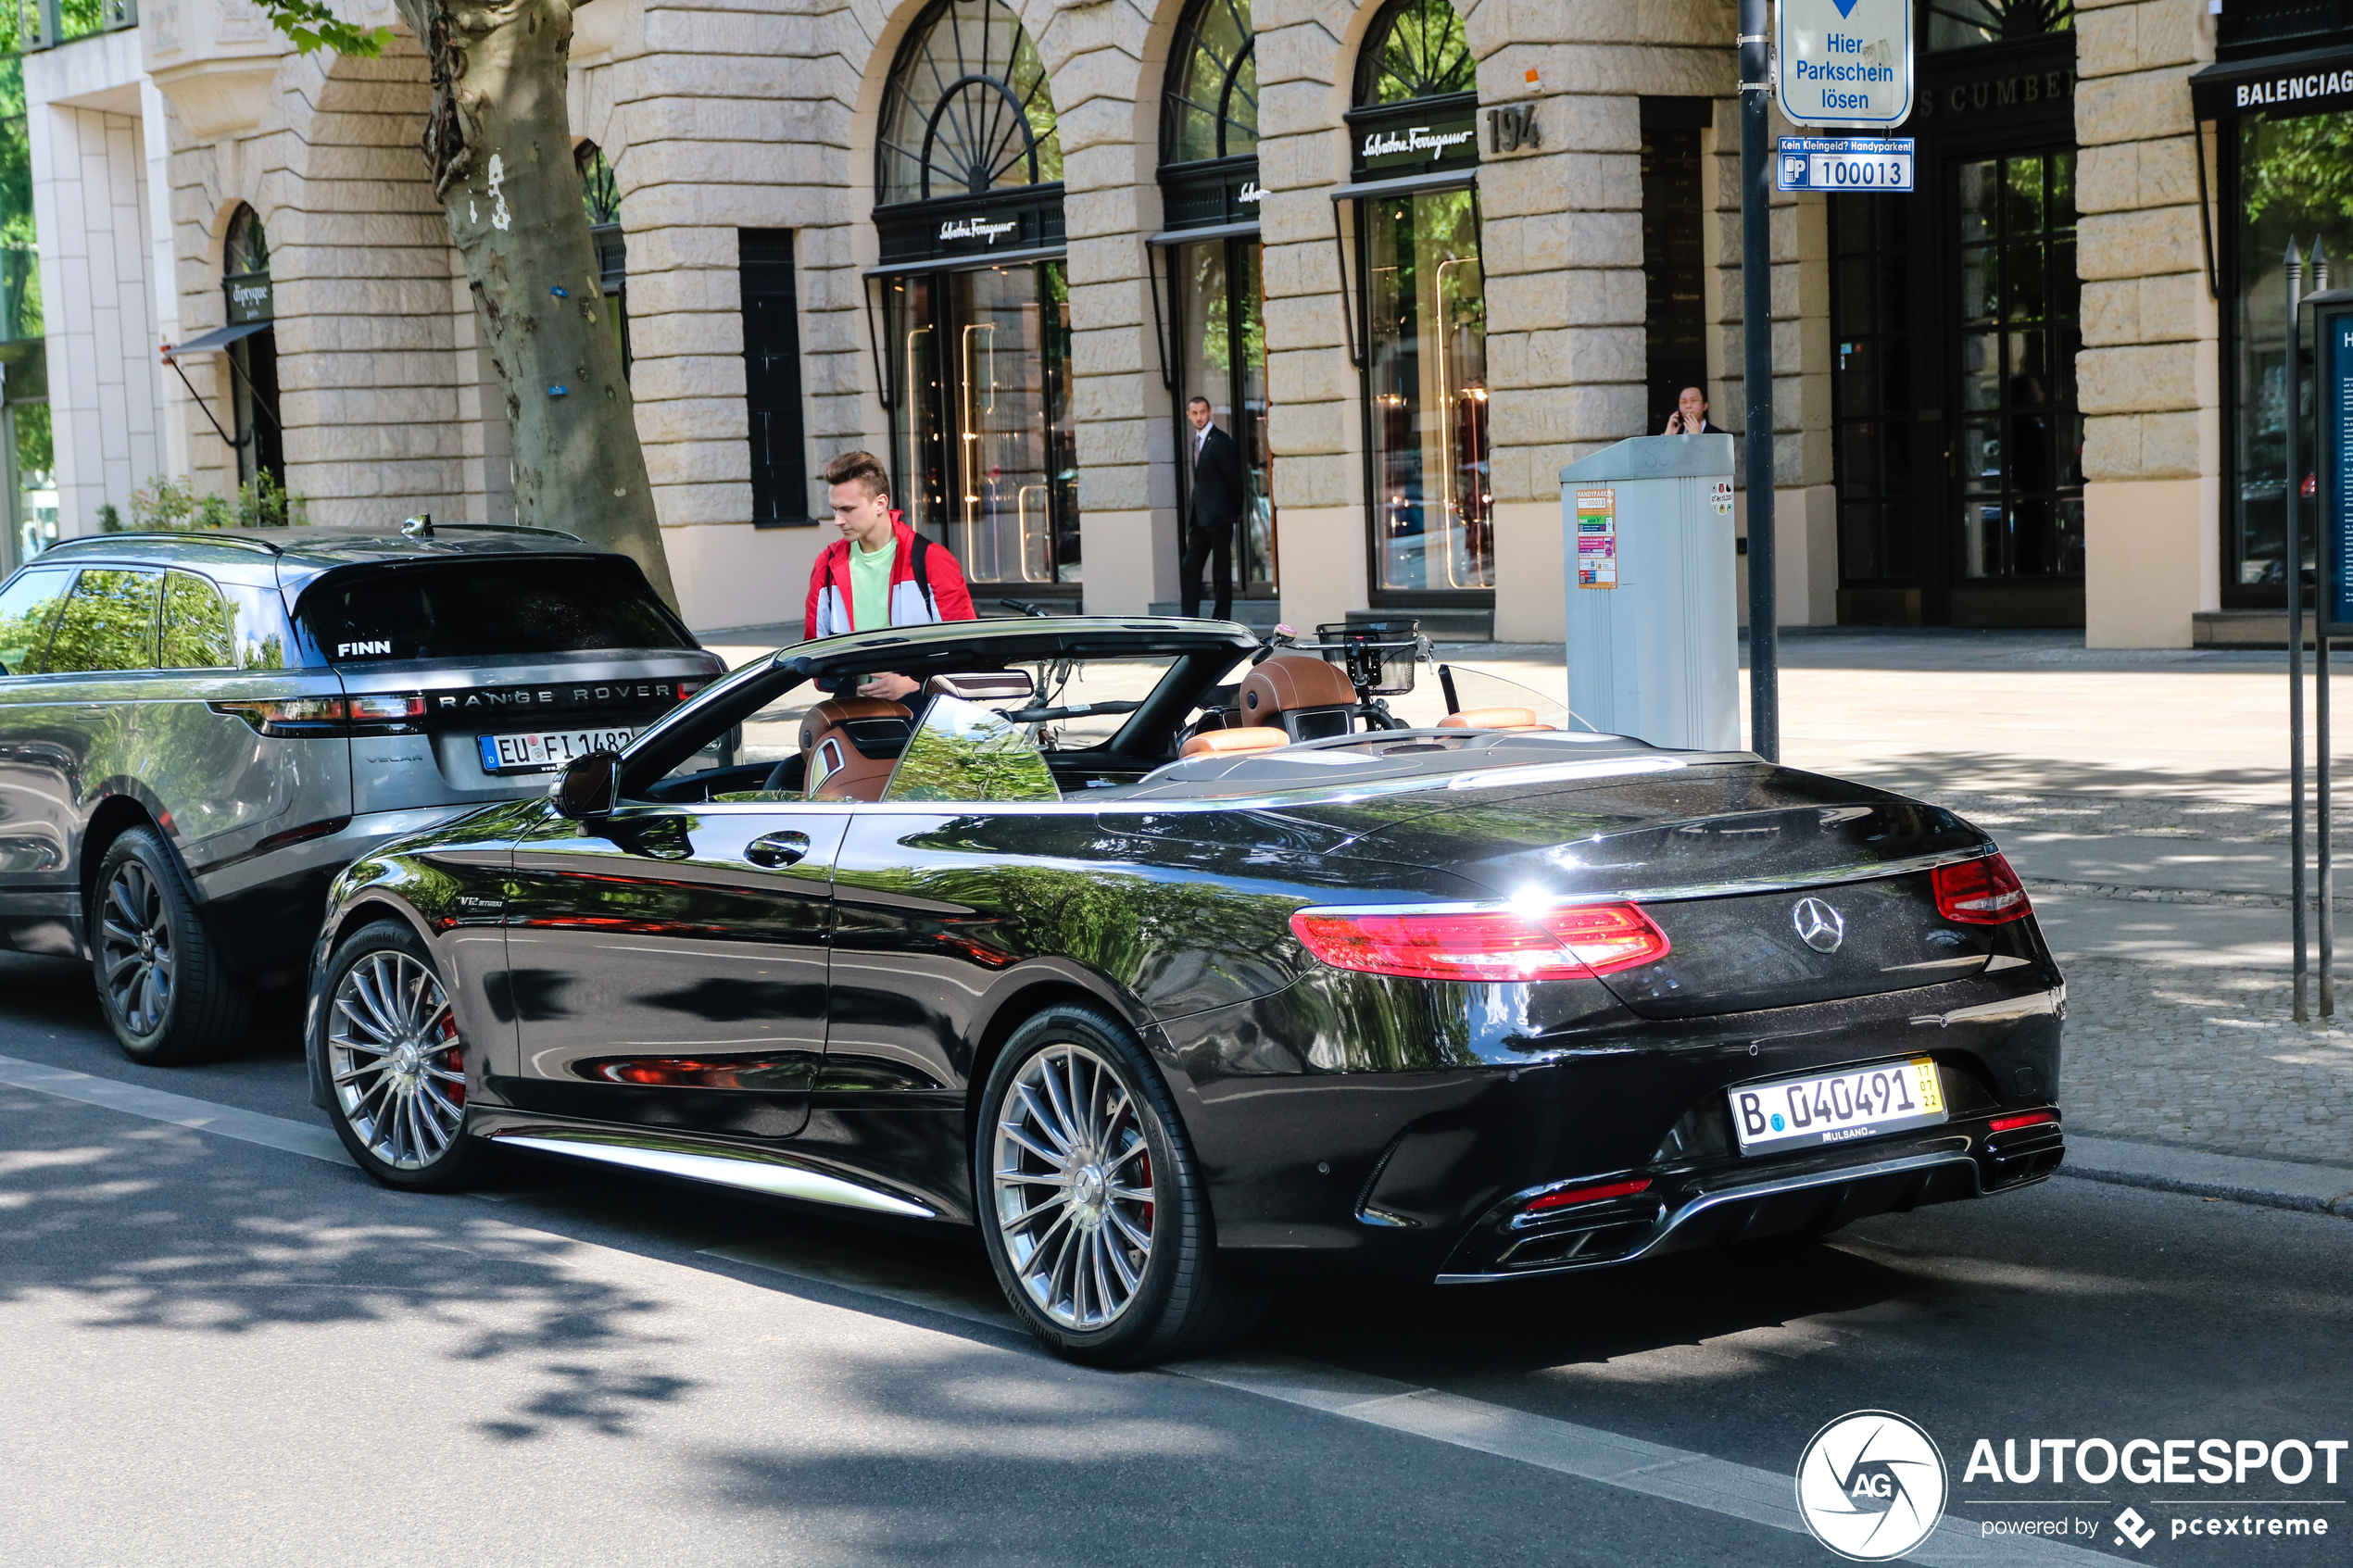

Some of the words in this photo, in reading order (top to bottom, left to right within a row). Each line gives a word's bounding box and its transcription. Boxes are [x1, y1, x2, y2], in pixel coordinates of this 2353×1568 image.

[1827, 33, 1863, 53] Hier
[1797, 60, 1893, 82] Parkschein
[1822, 89, 1869, 108] lösen
[2236, 69, 2353, 107] BALENCIAG
[1487, 105, 1539, 154] 194
[1362, 132, 1409, 157] Salvatore
[1409, 127, 1473, 160] Ferragamo
[1781, 141, 1800, 150] Kein
[1803, 141, 1848, 152] Kleingeld?
[1851, 142, 1911, 153] Handyparken!
[1823, 162, 1901, 184] 100013
[939, 220, 972, 240] Salvatore
[971, 217, 1016, 245] Ferragamo
[233, 283, 268, 307] diptyque
[338, 641, 390, 657] FINN
[439, 691, 552, 708] RANGE
[574, 684, 670, 699] ROVER
[366, 755, 422, 763] VELAR
[488, 756, 495, 764] D
[498, 737, 530, 764] EU
[543, 735, 573, 760] FI
[460, 897, 479, 906] V12
[1918, 1065, 1929, 1077] 17
[1920, 1080, 1932, 1091] 07
[1740, 1093, 1767, 1136] B
[1787, 1070, 1915, 1128] 040491
[1923, 1095, 1937, 1107] 22
